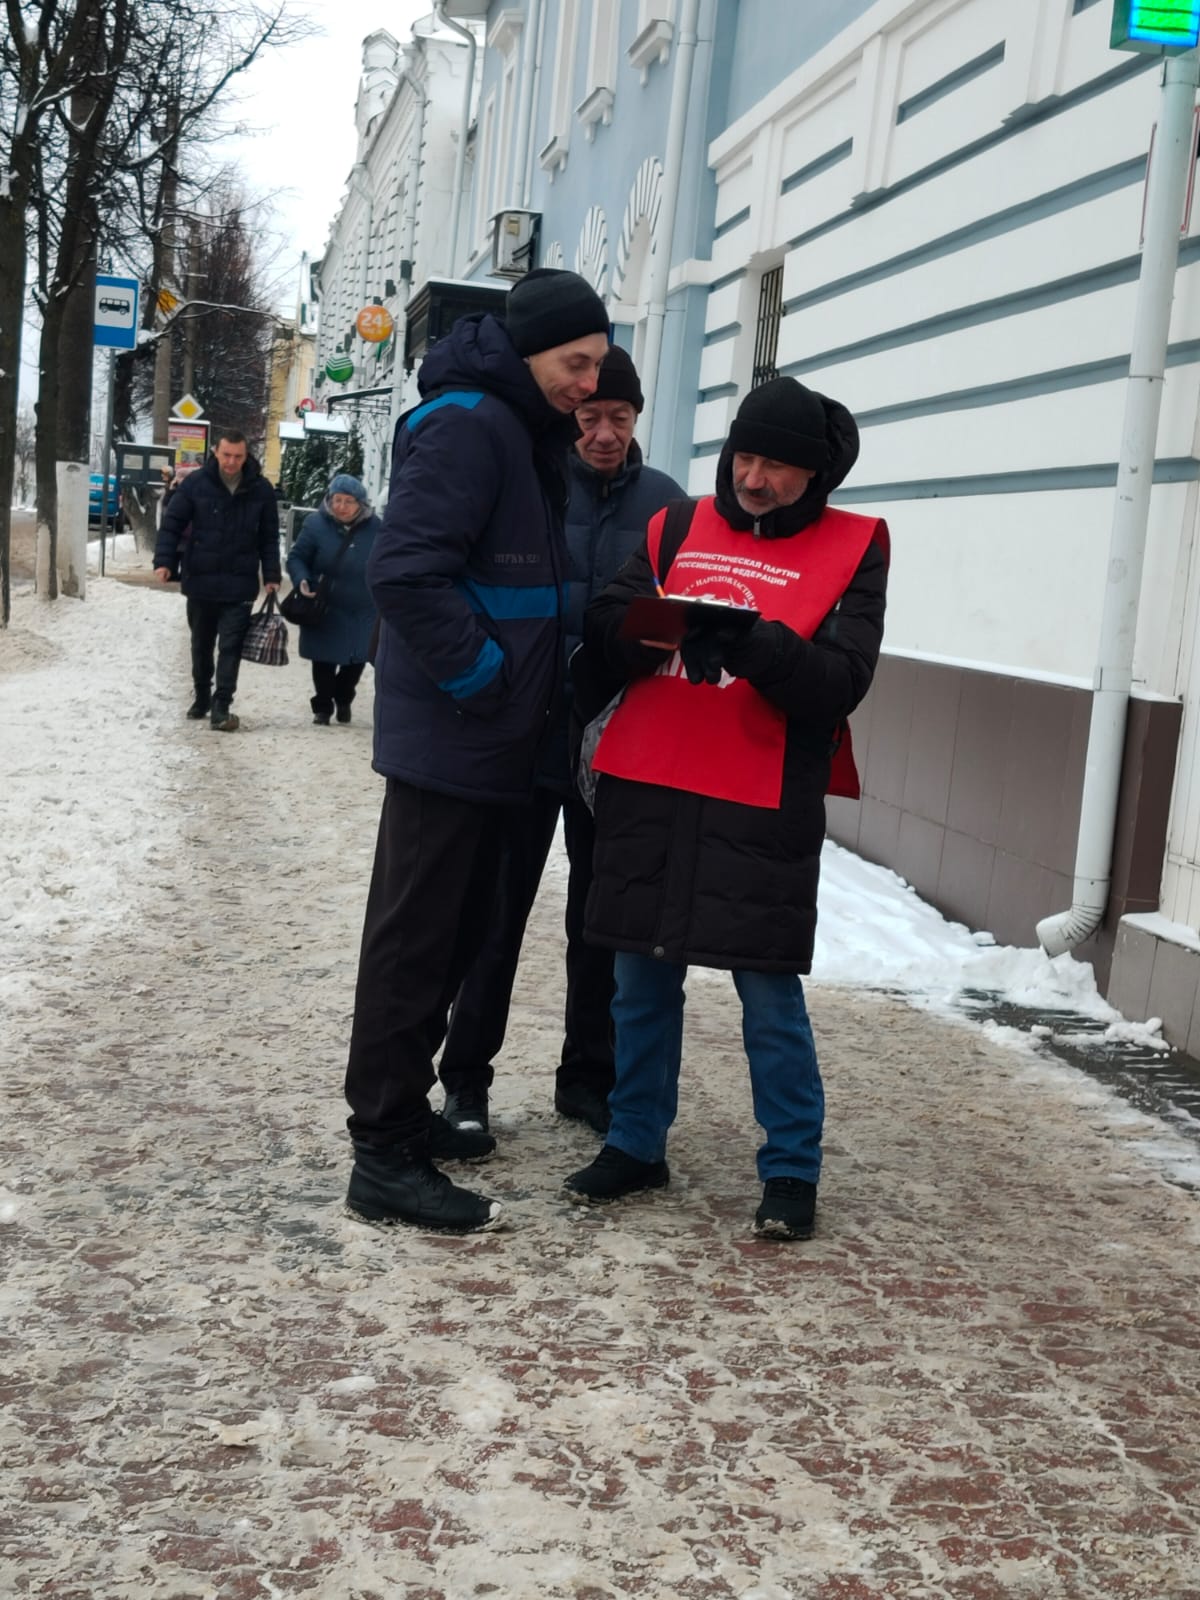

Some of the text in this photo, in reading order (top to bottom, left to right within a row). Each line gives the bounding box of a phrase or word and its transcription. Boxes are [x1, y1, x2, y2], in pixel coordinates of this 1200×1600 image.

[361, 312, 382, 327] 24
[677, 561, 788, 586] РОССИЙСКОЙ ФЕДЕРАЦИИ
[763, 564, 800, 580] ПАРТИЯ
